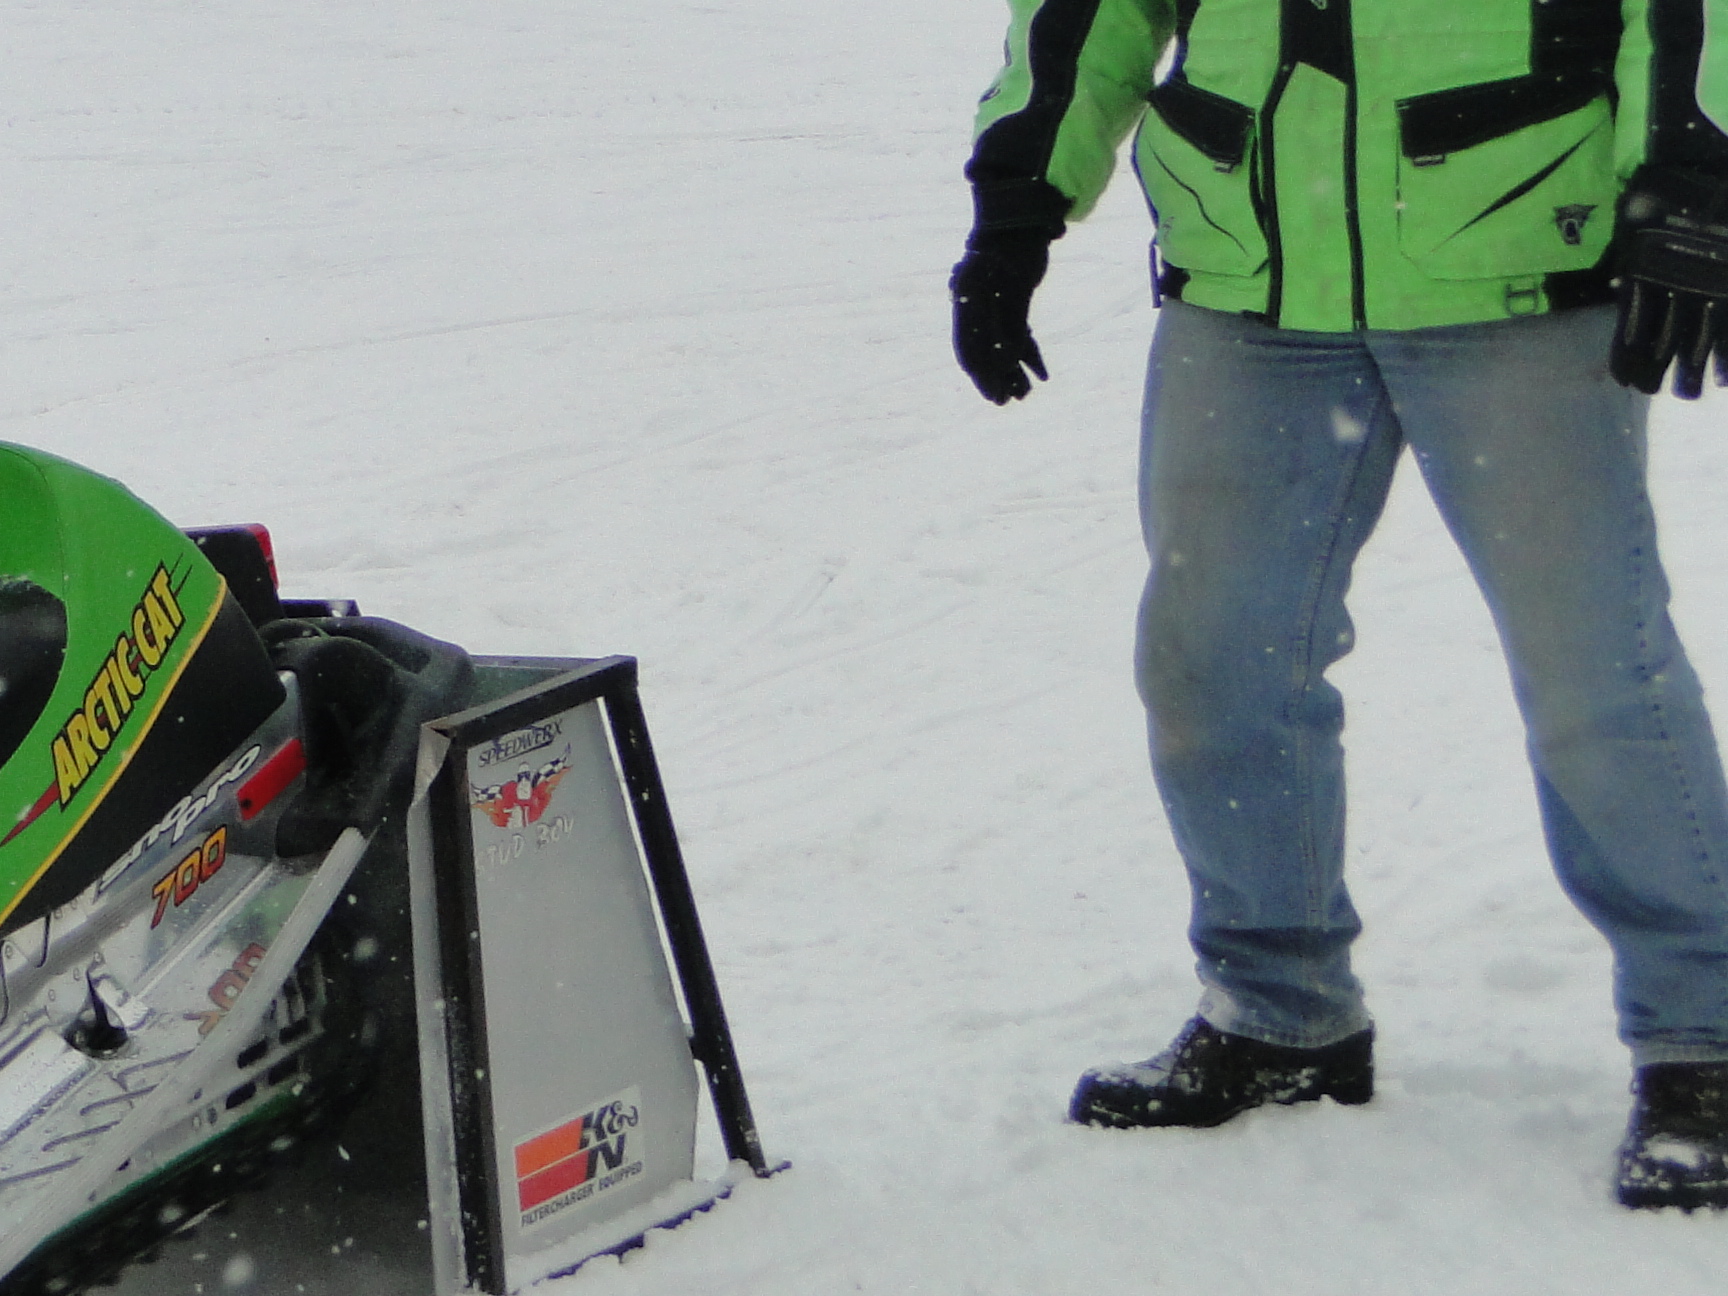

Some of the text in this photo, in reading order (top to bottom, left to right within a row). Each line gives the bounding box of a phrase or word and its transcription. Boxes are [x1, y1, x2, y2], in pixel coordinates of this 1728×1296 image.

[51, 559, 186, 812] ARCTIC CAT
[150, 824, 227, 930] 700
